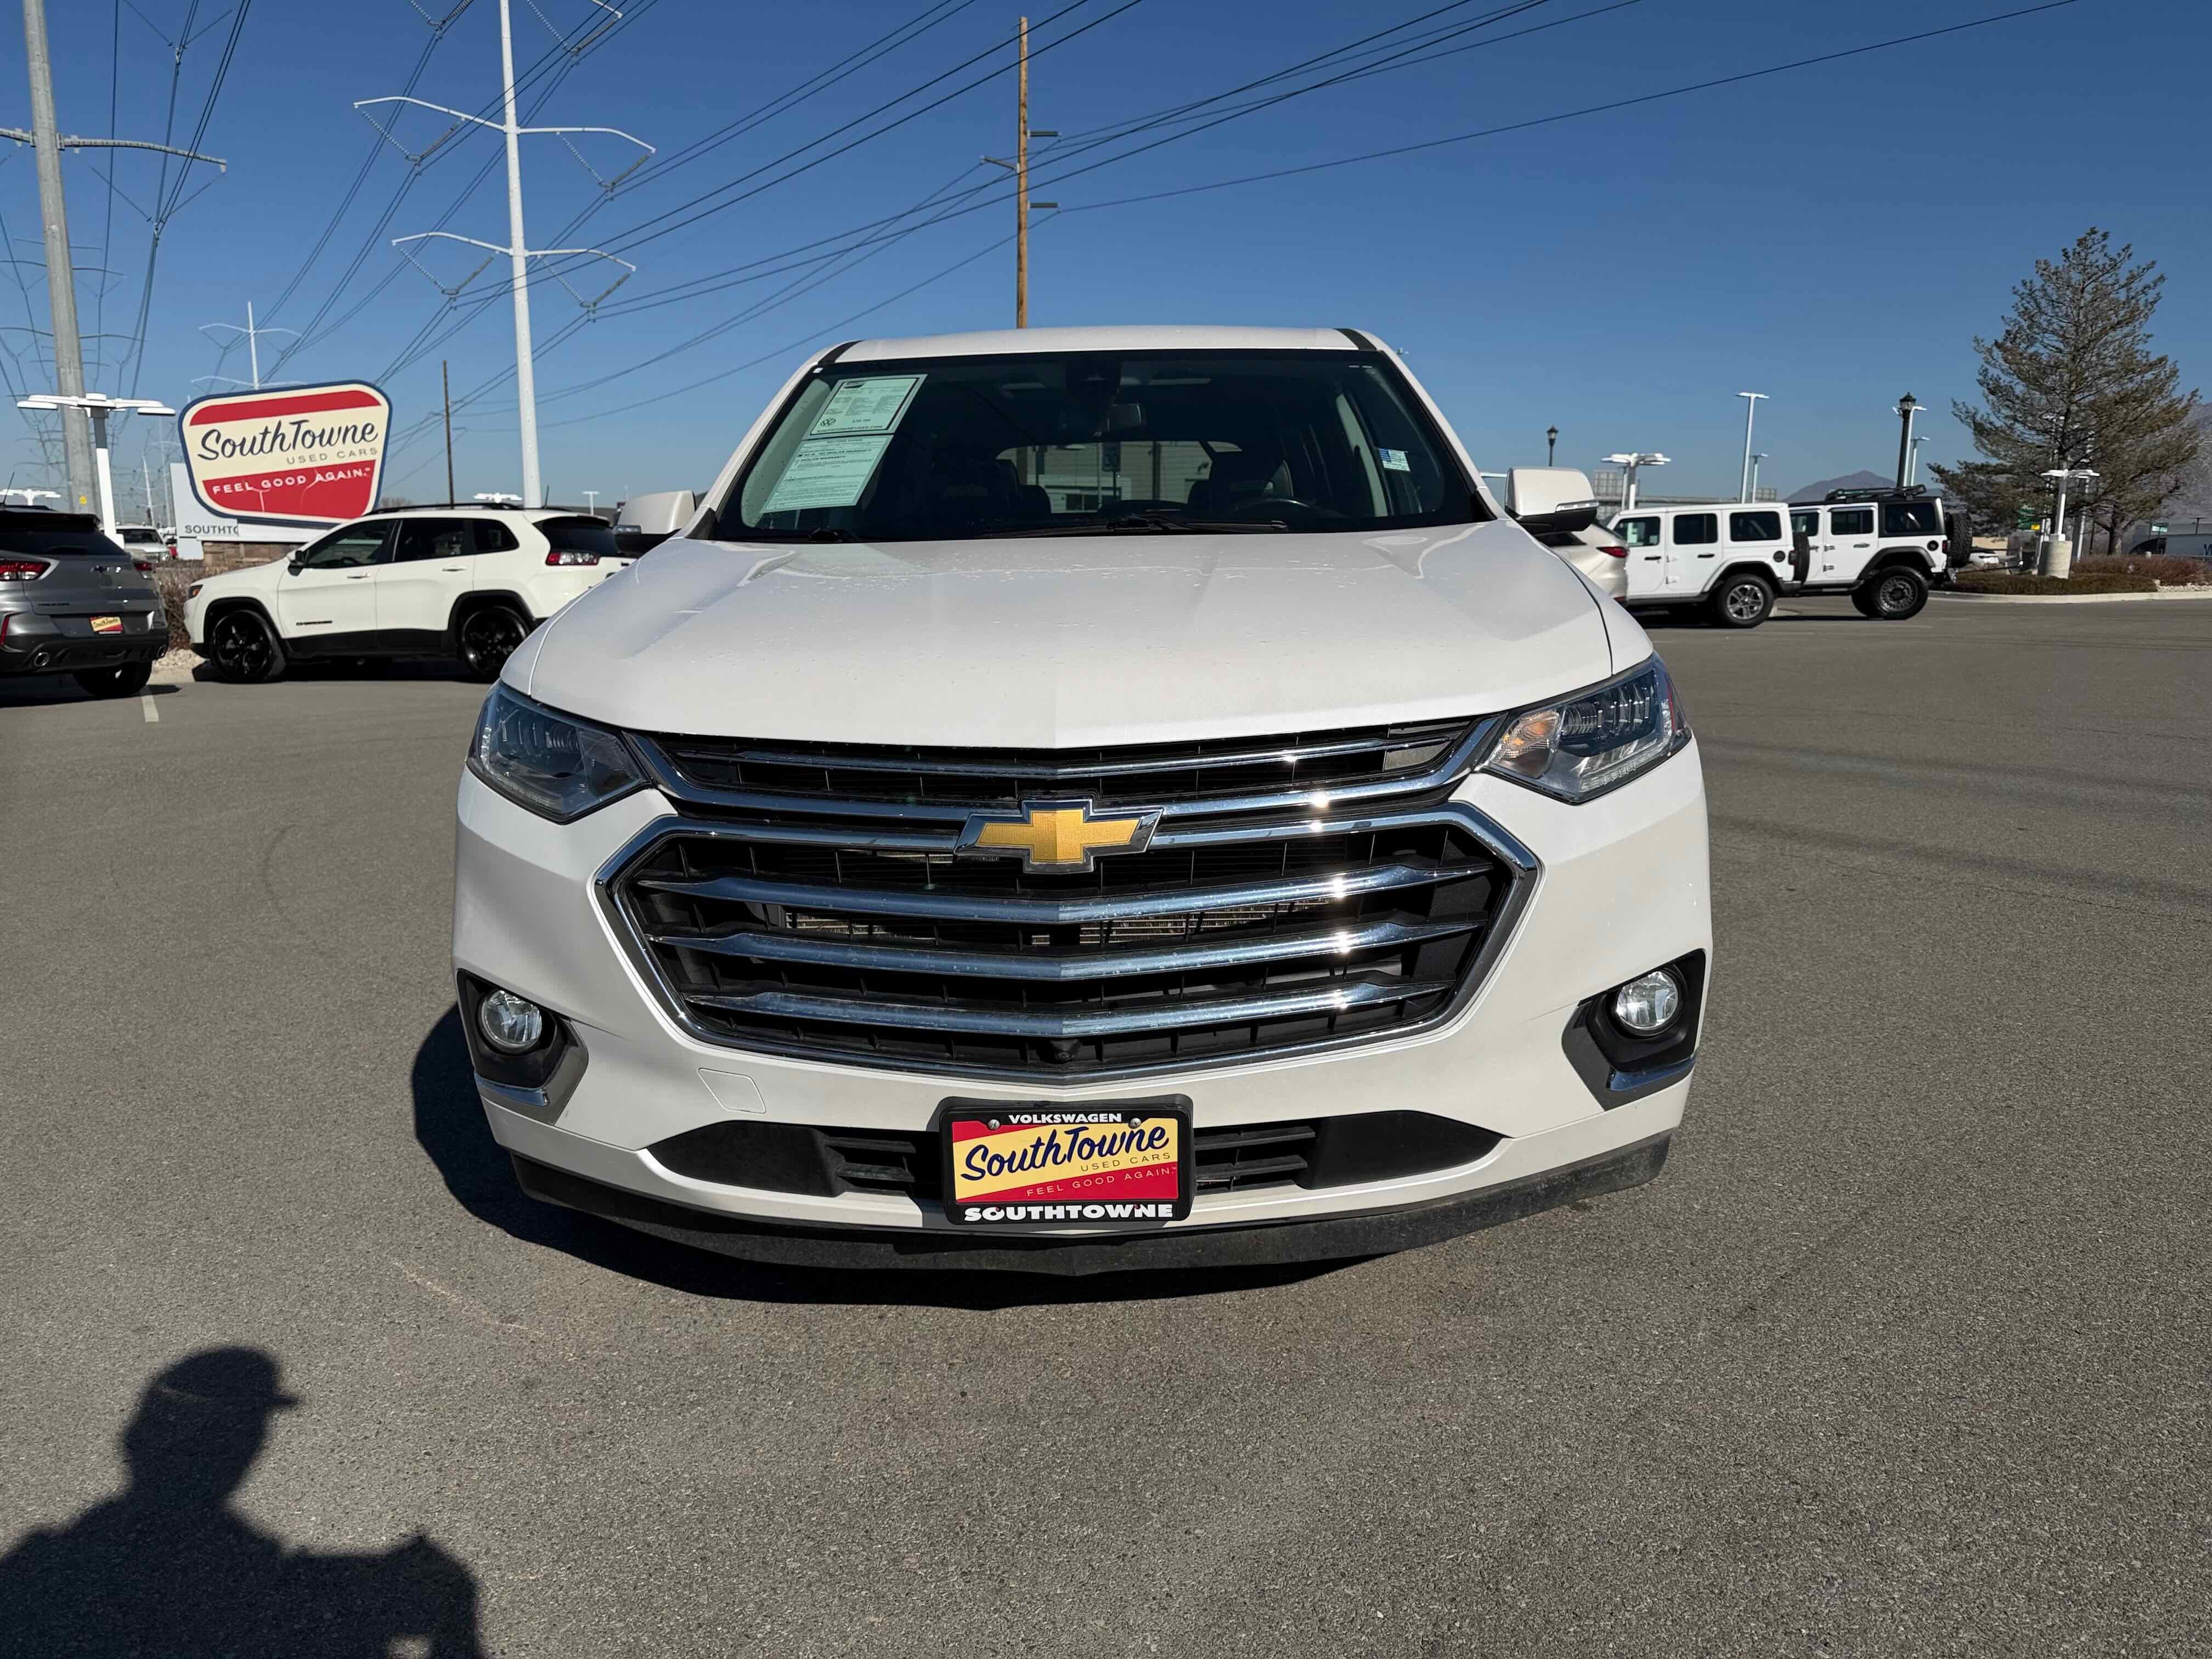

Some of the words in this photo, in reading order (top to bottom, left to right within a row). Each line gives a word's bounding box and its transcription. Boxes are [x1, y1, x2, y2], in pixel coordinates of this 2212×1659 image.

[286, 452, 328, 465] USED
[337, 447, 377, 459] CARS
[212, 482, 253, 494] FEEL
[261, 475, 307, 489] GOOD
[1008, 1113, 1122, 1124] VOLKSWAGEN
[1080, 1159, 1121, 1172] USED
[1130, 1152, 1171, 1164] CARS
[1027, 1184, 1064, 1197] FEEL
[1072, 1175, 1115, 1189] GOOD
[964, 1204, 1173, 1221] SOUTHTOWNE
